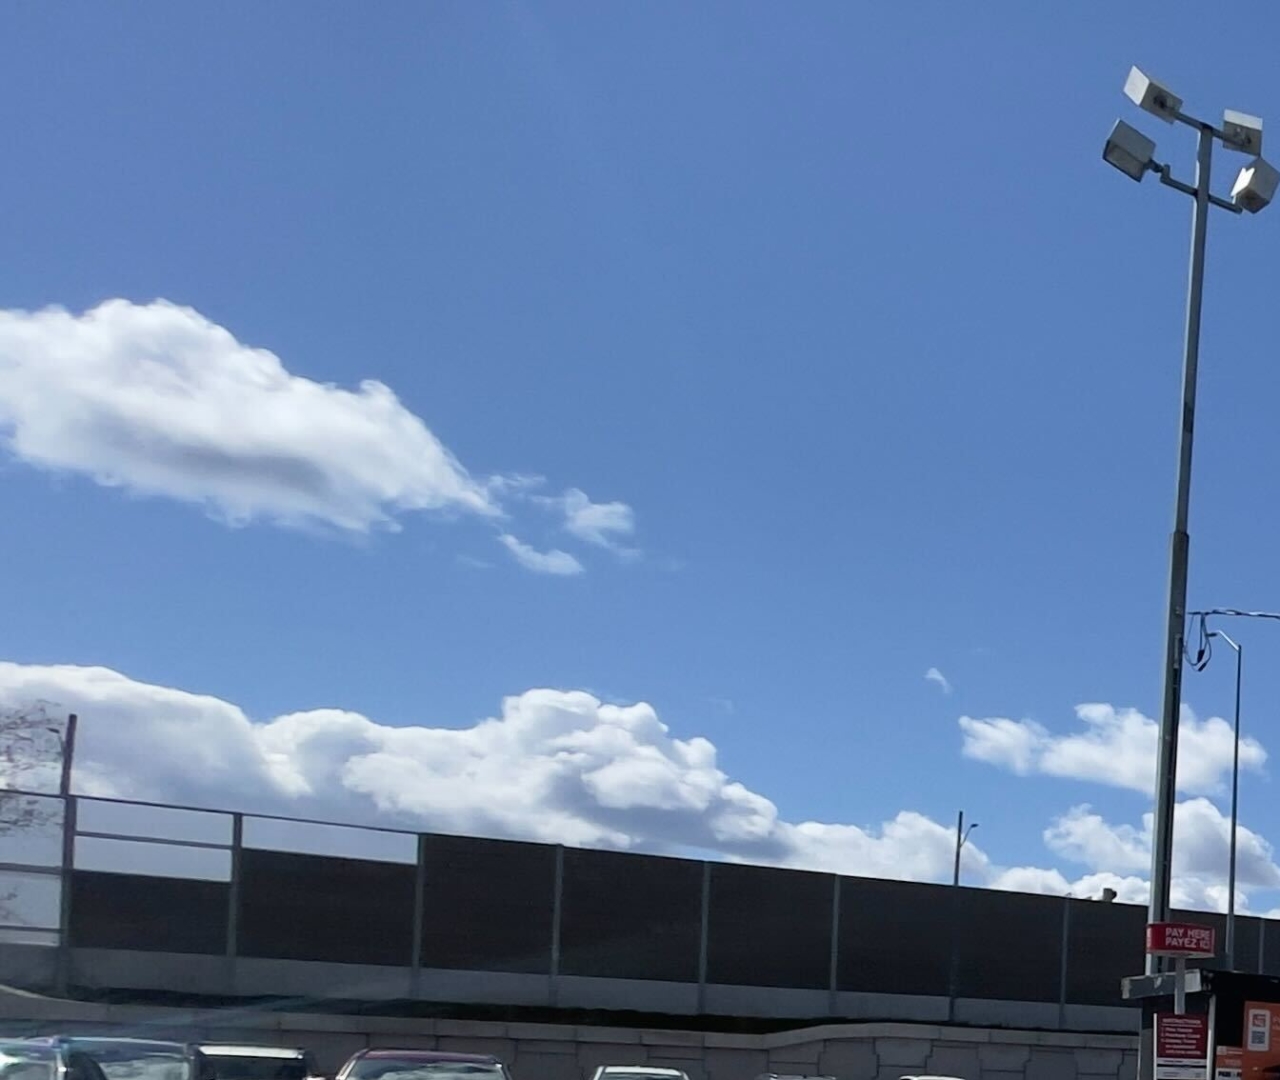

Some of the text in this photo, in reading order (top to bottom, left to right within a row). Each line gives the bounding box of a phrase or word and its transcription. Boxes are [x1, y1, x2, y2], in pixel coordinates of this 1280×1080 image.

[1165, 927, 1210, 940] PAY HERE
[1165, 937, 1197, 948] PAYEZ
